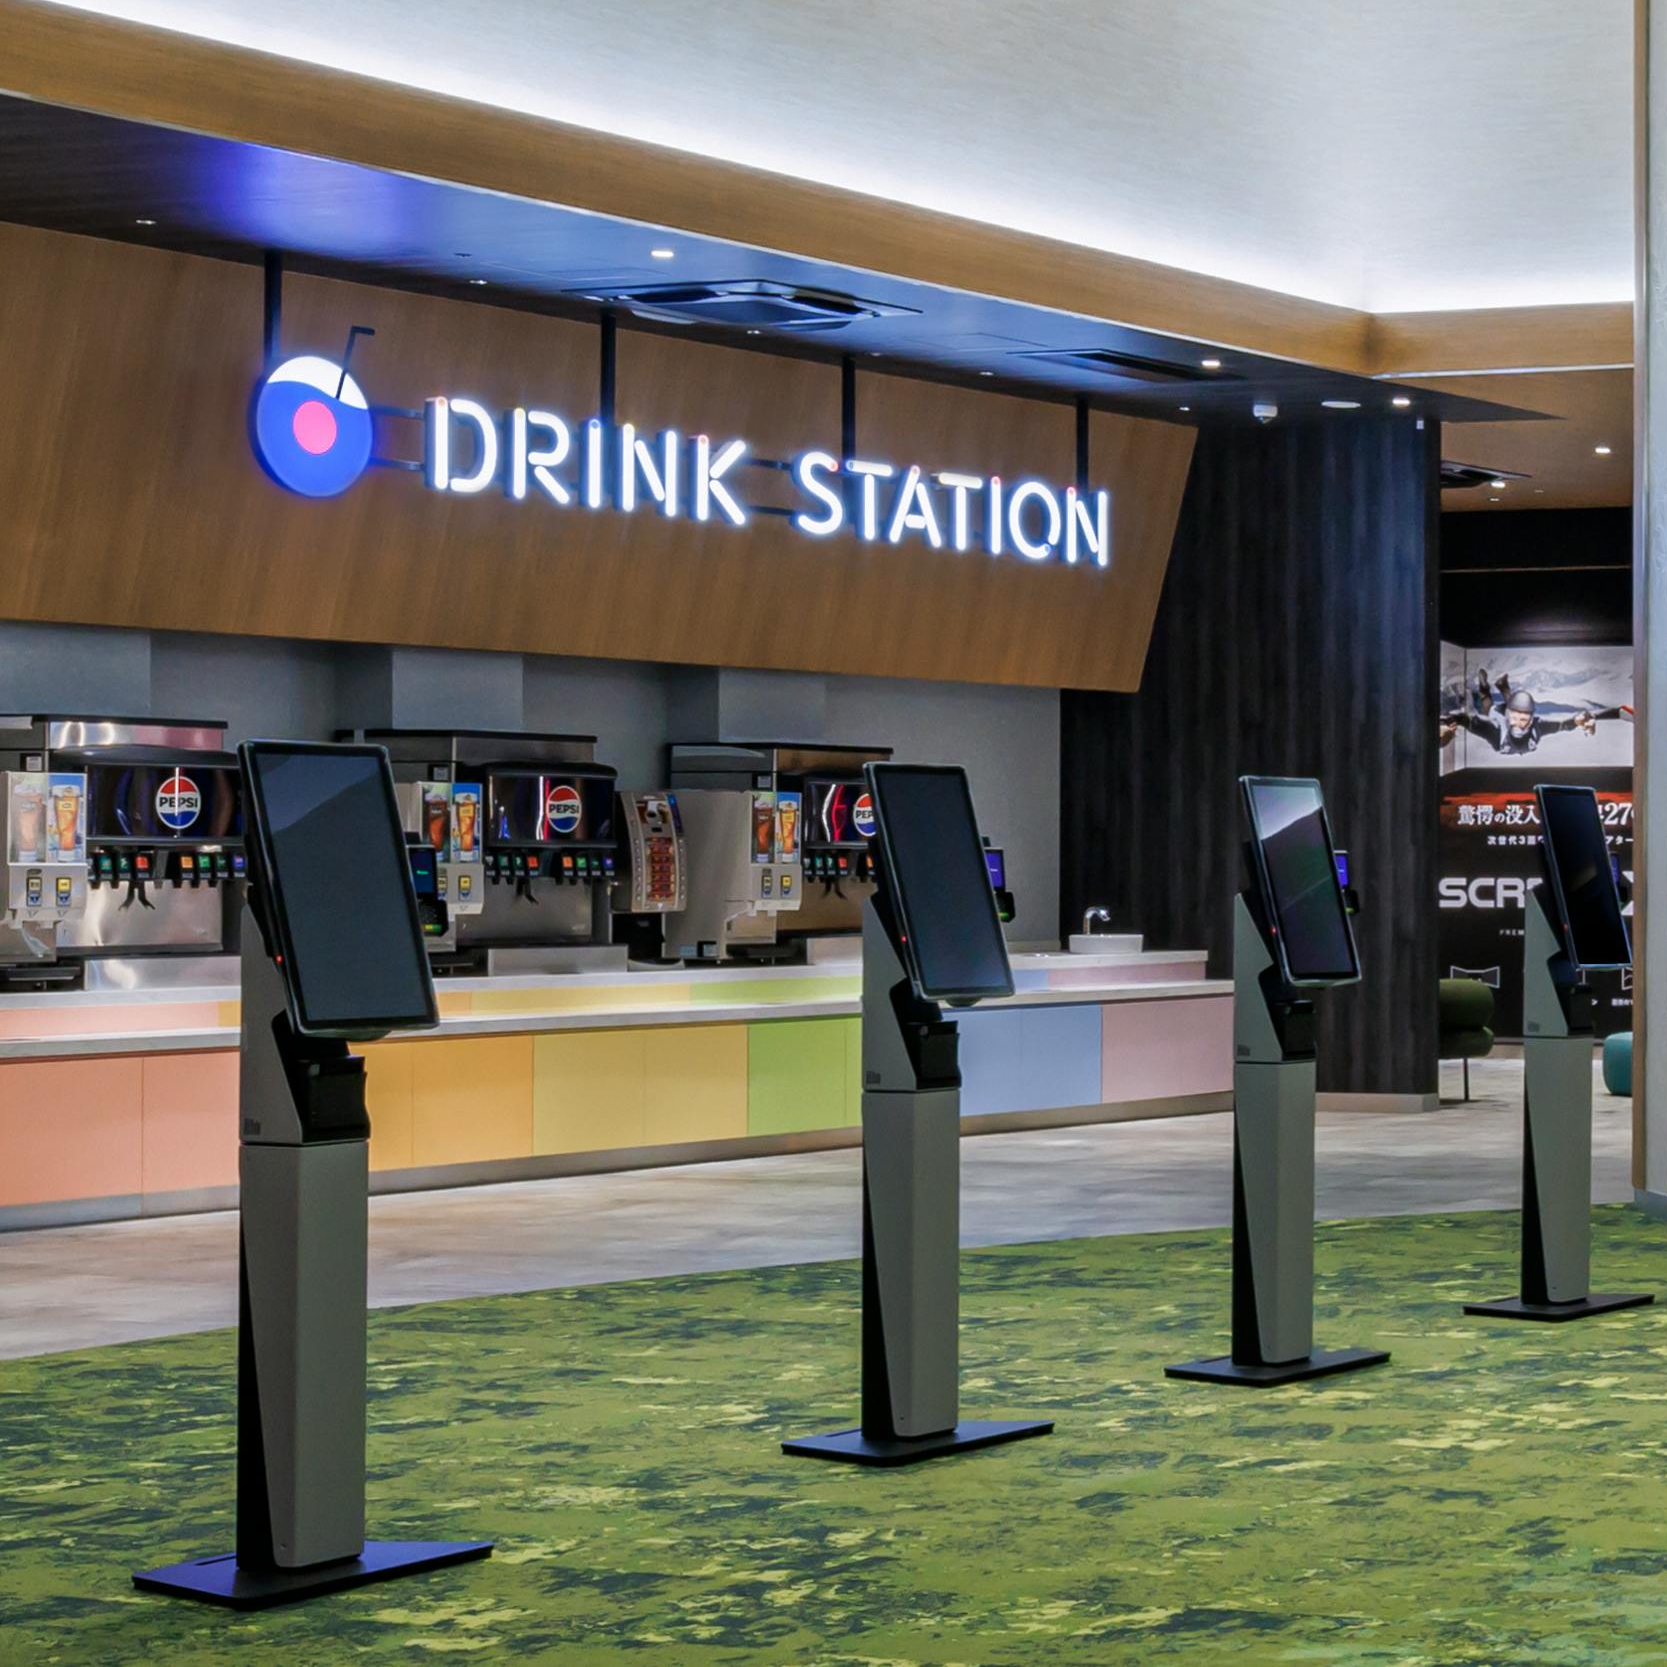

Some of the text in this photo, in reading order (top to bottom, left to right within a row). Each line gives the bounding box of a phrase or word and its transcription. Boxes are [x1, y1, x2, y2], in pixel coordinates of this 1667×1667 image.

[425, 396, 1110, 568] DRINK STATION
[159, 797, 198, 808] PEPSI
[550, 804, 579, 815] PEPSI
[856, 809, 874, 820] PEP
